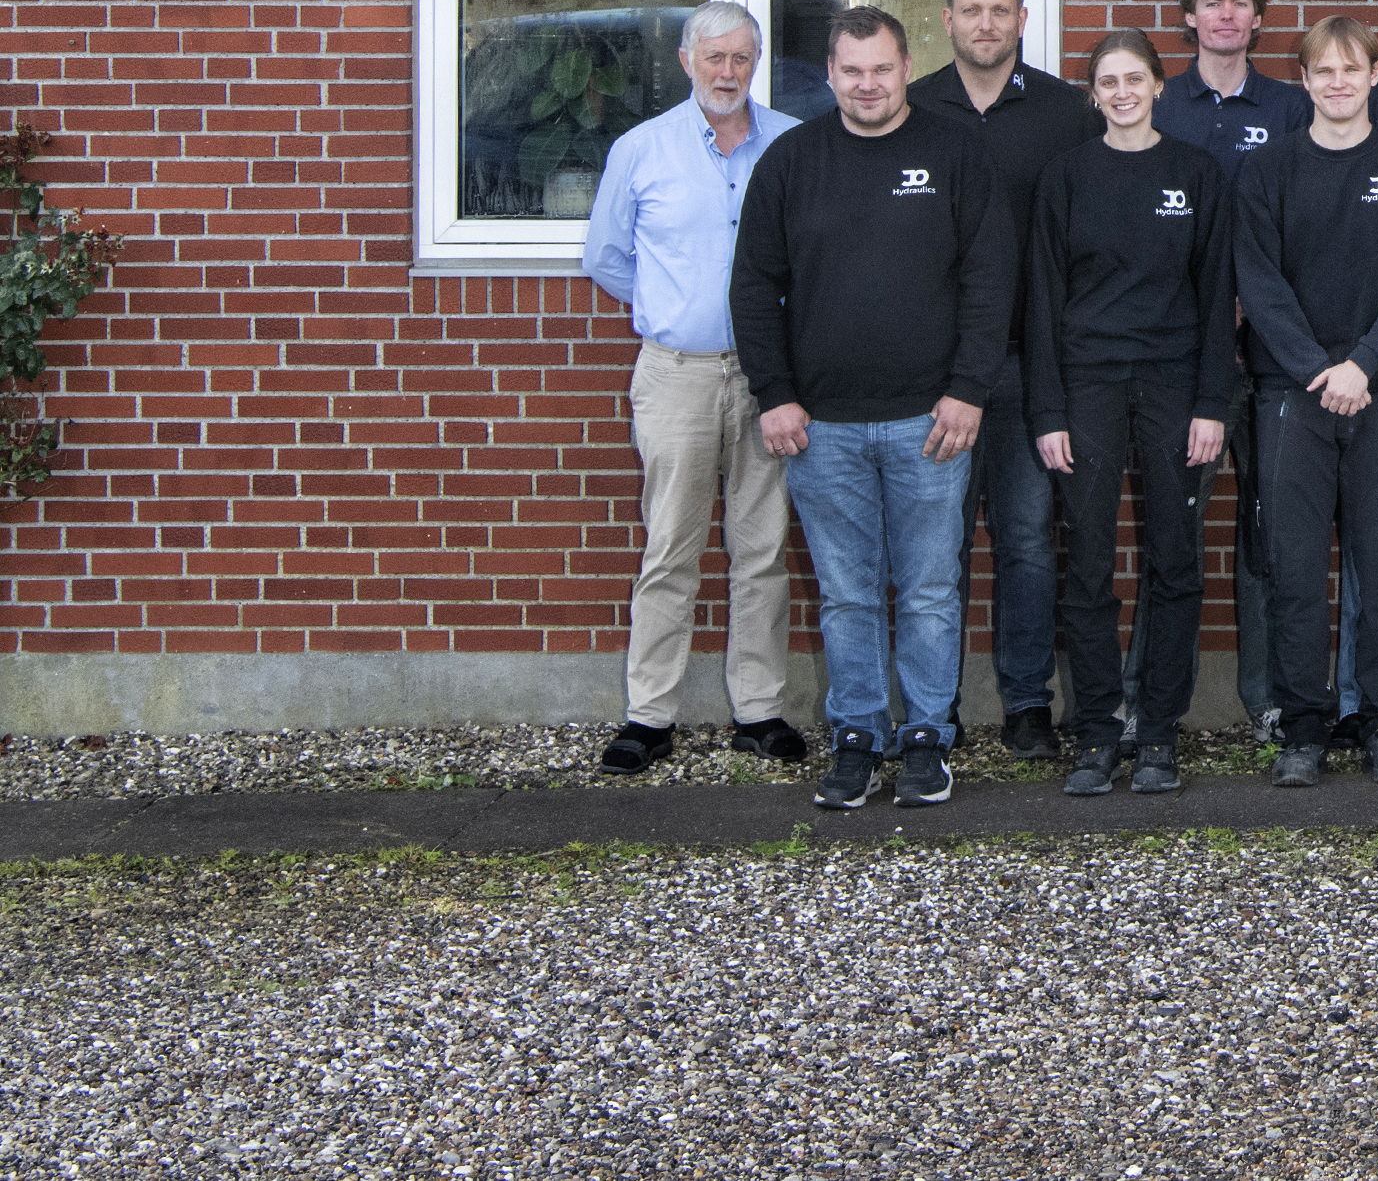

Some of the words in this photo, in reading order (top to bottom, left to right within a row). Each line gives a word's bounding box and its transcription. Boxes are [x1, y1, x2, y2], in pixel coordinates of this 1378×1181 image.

[1243, 126, 1269, 144] JO
[900, 169, 930, 187] JO
[892, 186, 936, 197] Hydraulics
[1162, 189, 1186, 209] JO
[1155, 208, 1194, 217] Hydraulic
